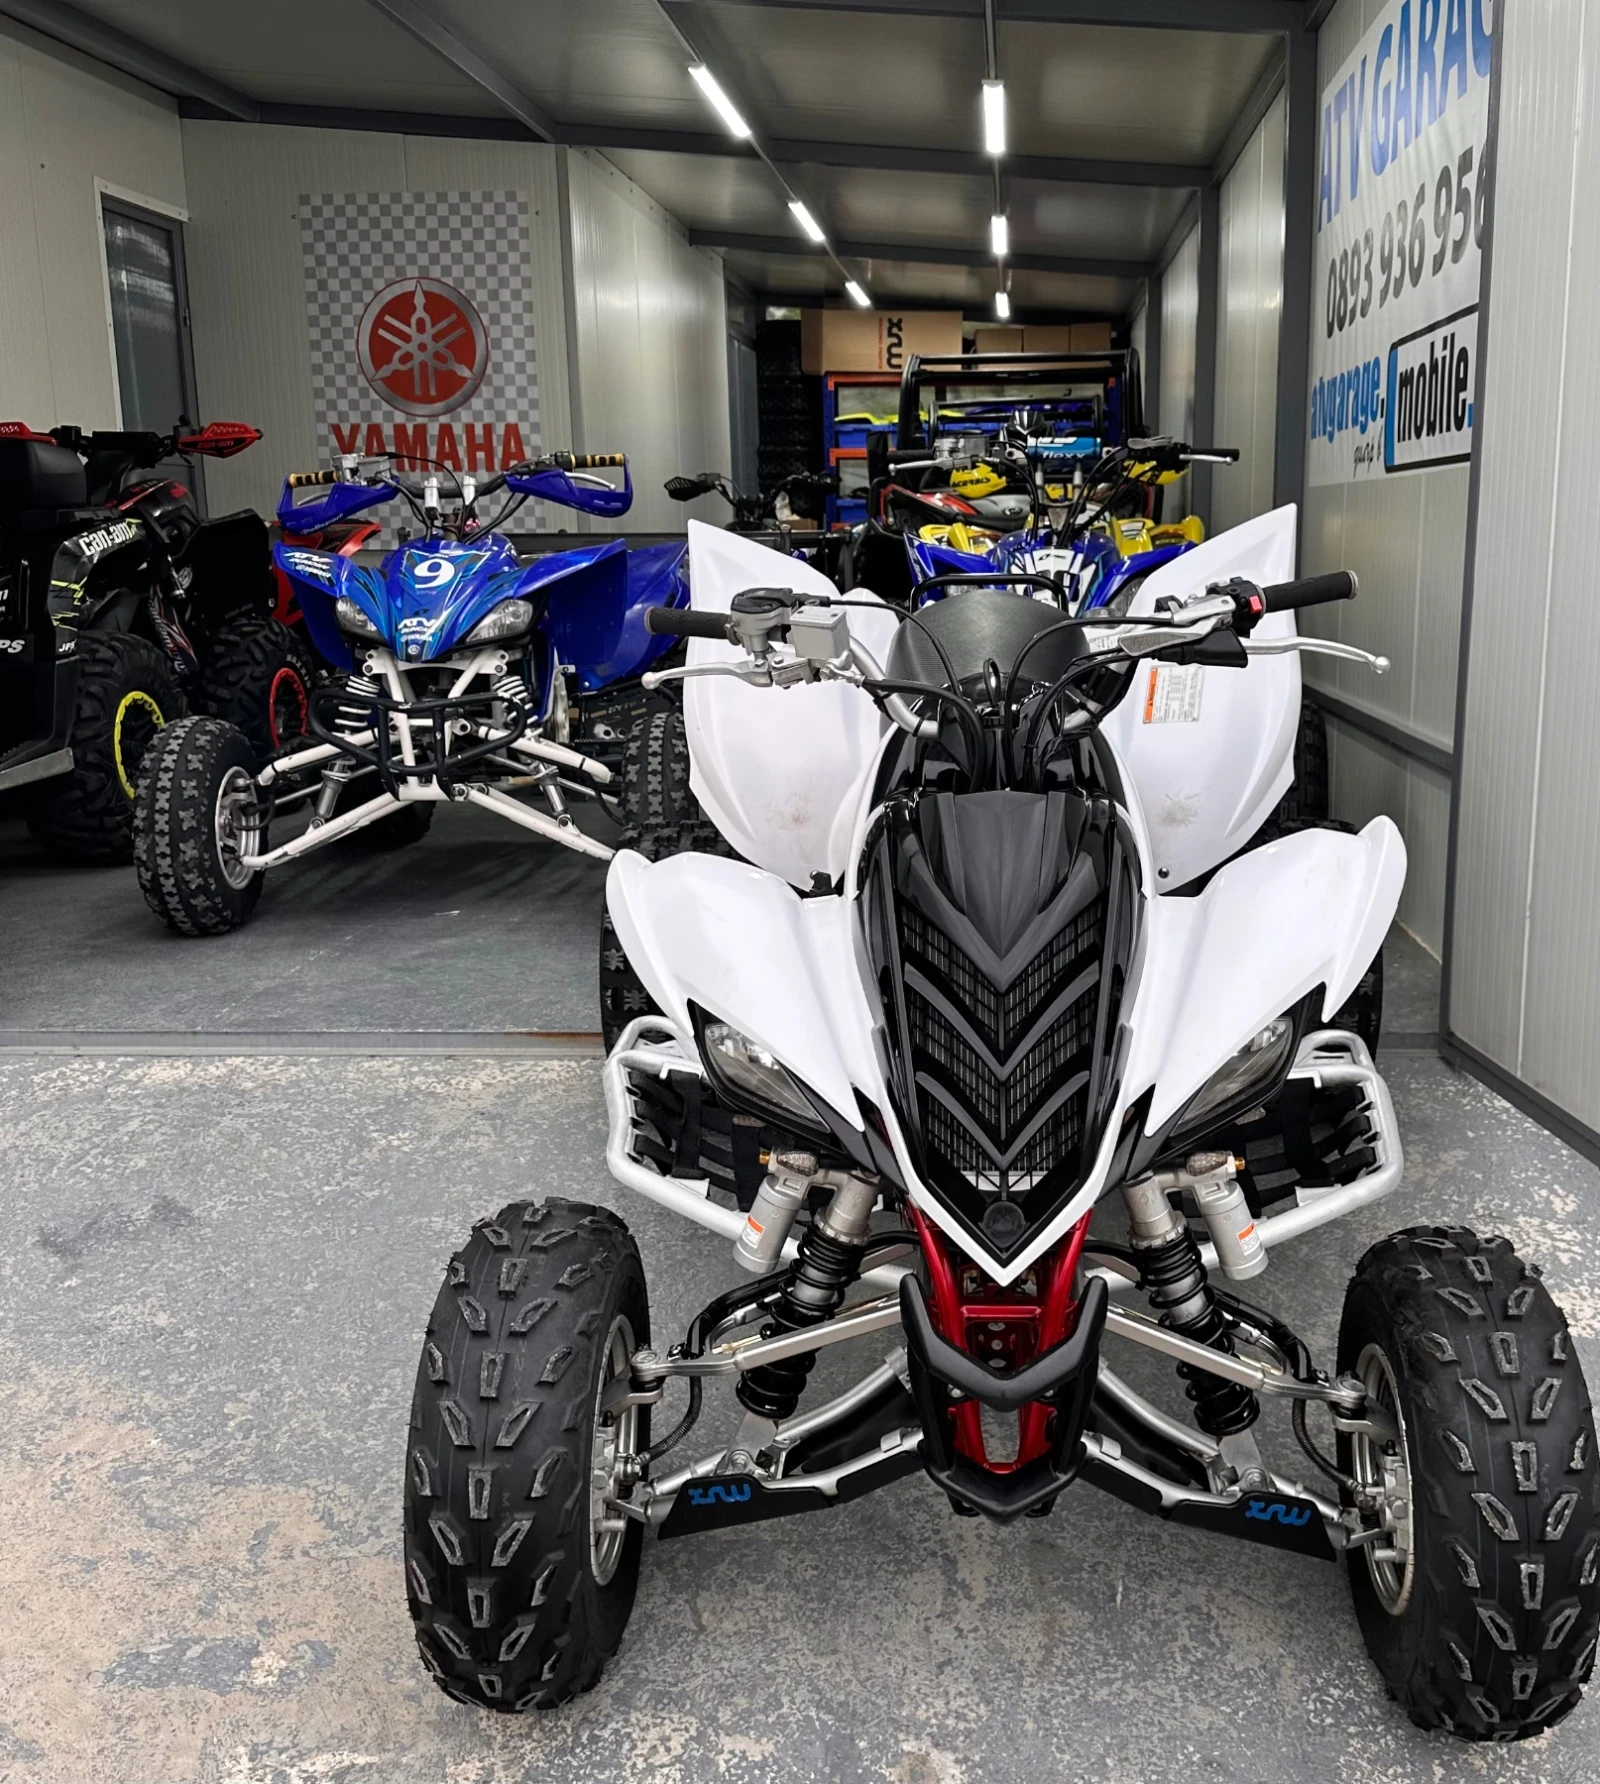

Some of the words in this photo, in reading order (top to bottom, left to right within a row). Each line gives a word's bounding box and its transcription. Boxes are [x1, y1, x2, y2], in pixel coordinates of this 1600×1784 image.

[1318, 54, 1367, 233] ATV
[1327, 227, 1373, 339] 0893
[1380, 182, 1425, 309] 936
[331, 423, 526, 472] YAMAHA
[414, 558, 455, 589] 9
[397, 617, 437, 629] ATV
